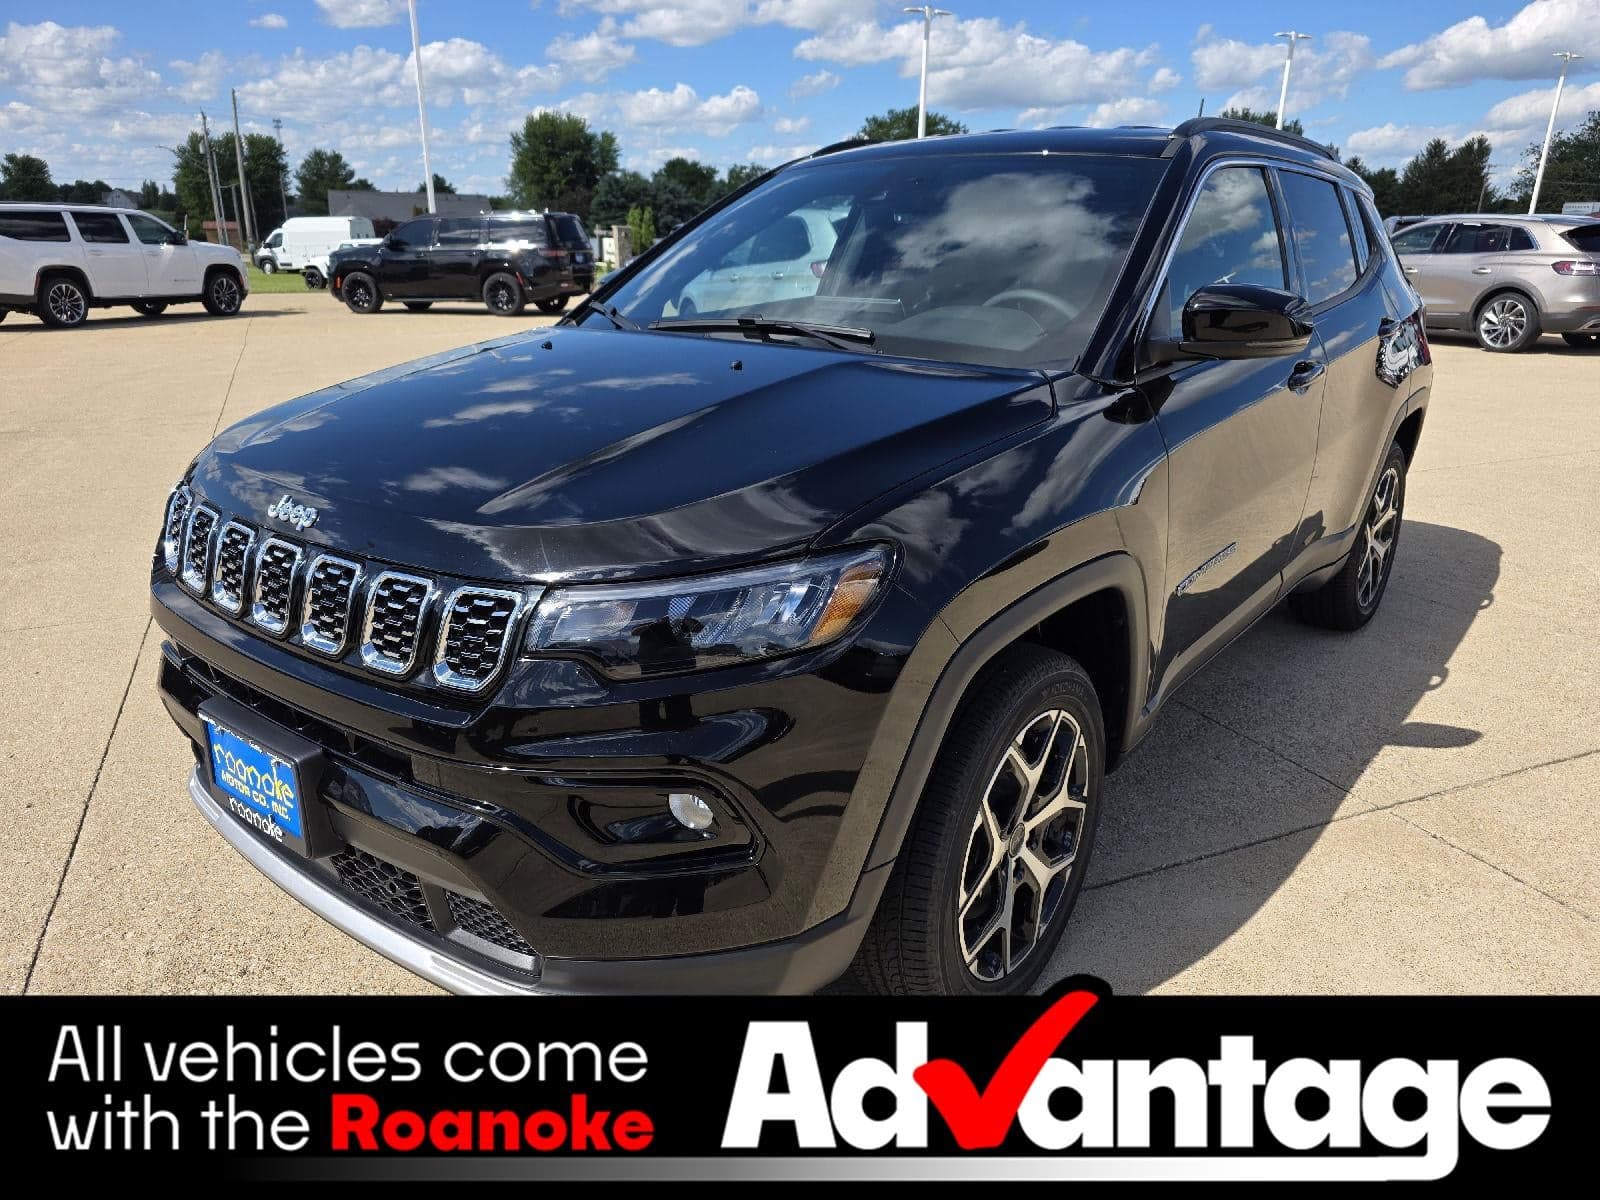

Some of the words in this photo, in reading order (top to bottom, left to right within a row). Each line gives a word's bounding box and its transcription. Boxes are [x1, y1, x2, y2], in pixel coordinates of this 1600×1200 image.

[268, 494, 319, 532] Jeep
[213, 743, 294, 809] roanoke
[221, 771, 251, 797] MOTOR
[229, 797, 284, 843] roanoke
